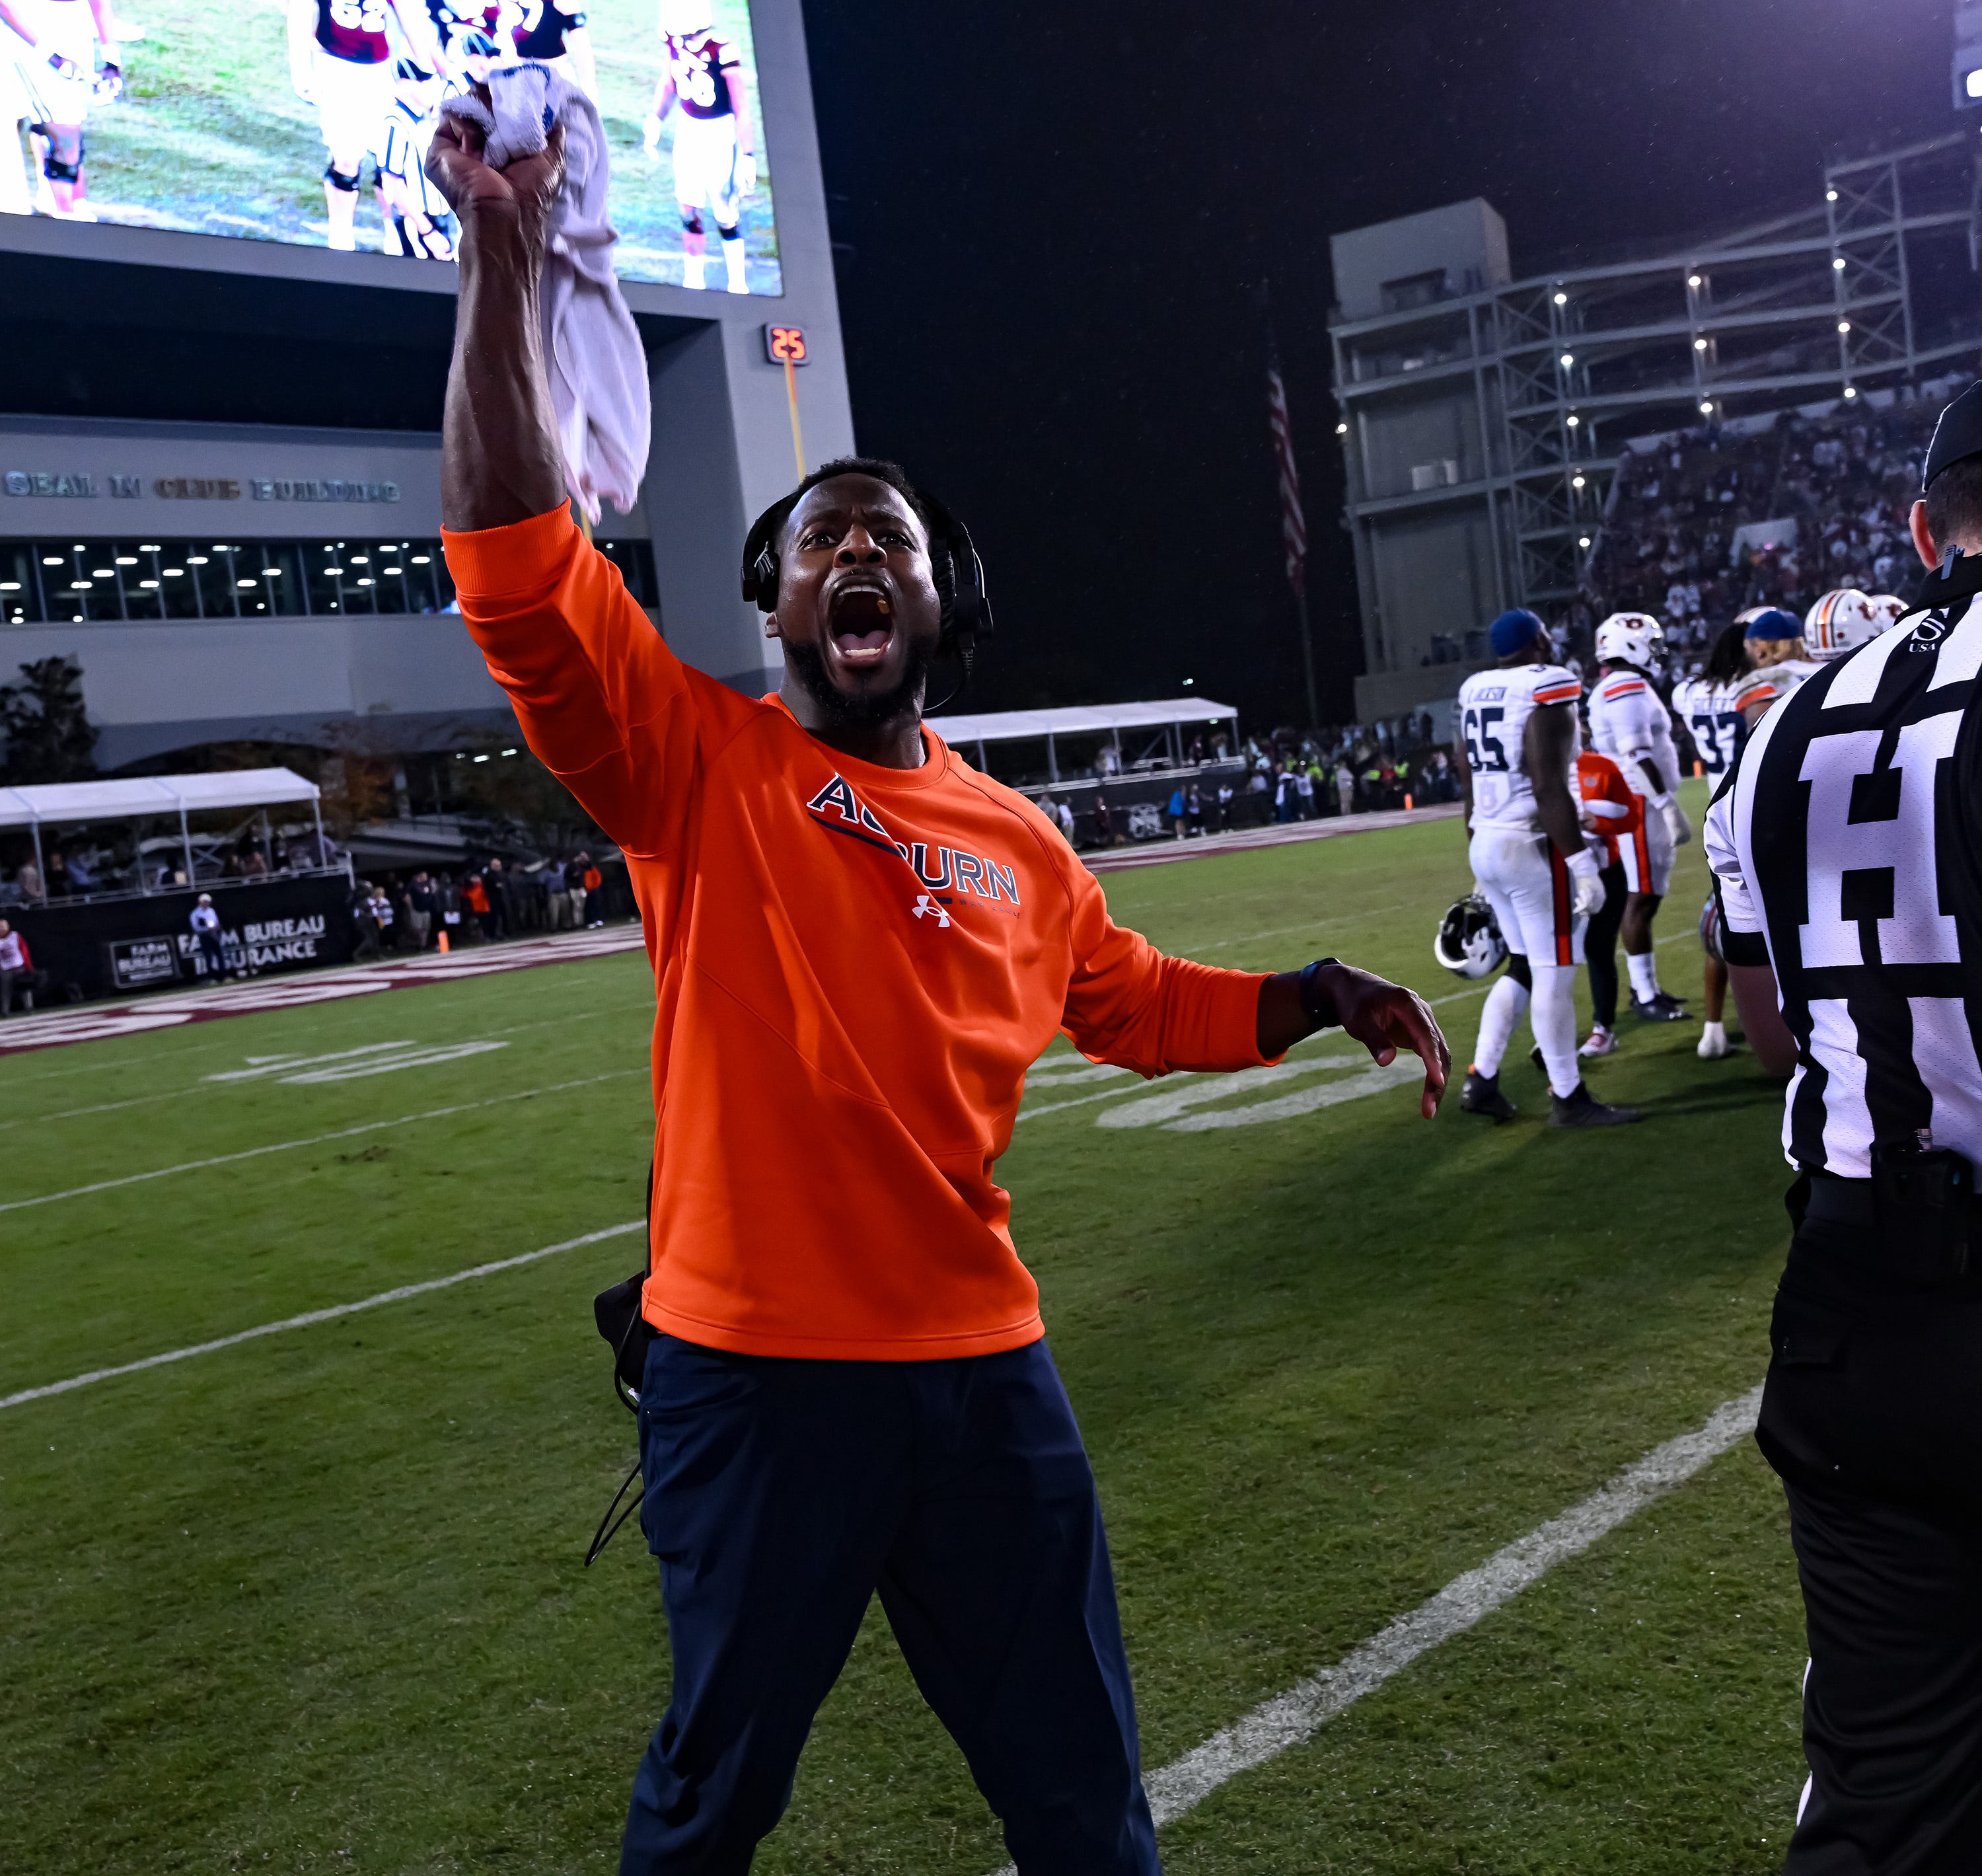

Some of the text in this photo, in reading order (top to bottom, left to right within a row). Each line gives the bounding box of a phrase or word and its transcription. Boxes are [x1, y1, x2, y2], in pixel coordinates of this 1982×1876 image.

[772, 328, 805, 359] 25
[248, 478, 401, 502] BUILDING
[1909, 643, 1936, 653] USA
[1465, 707, 1510, 772] 65
[1798, 709, 1965, 969] H
[177, 914, 326, 953] FAM BUREAU
